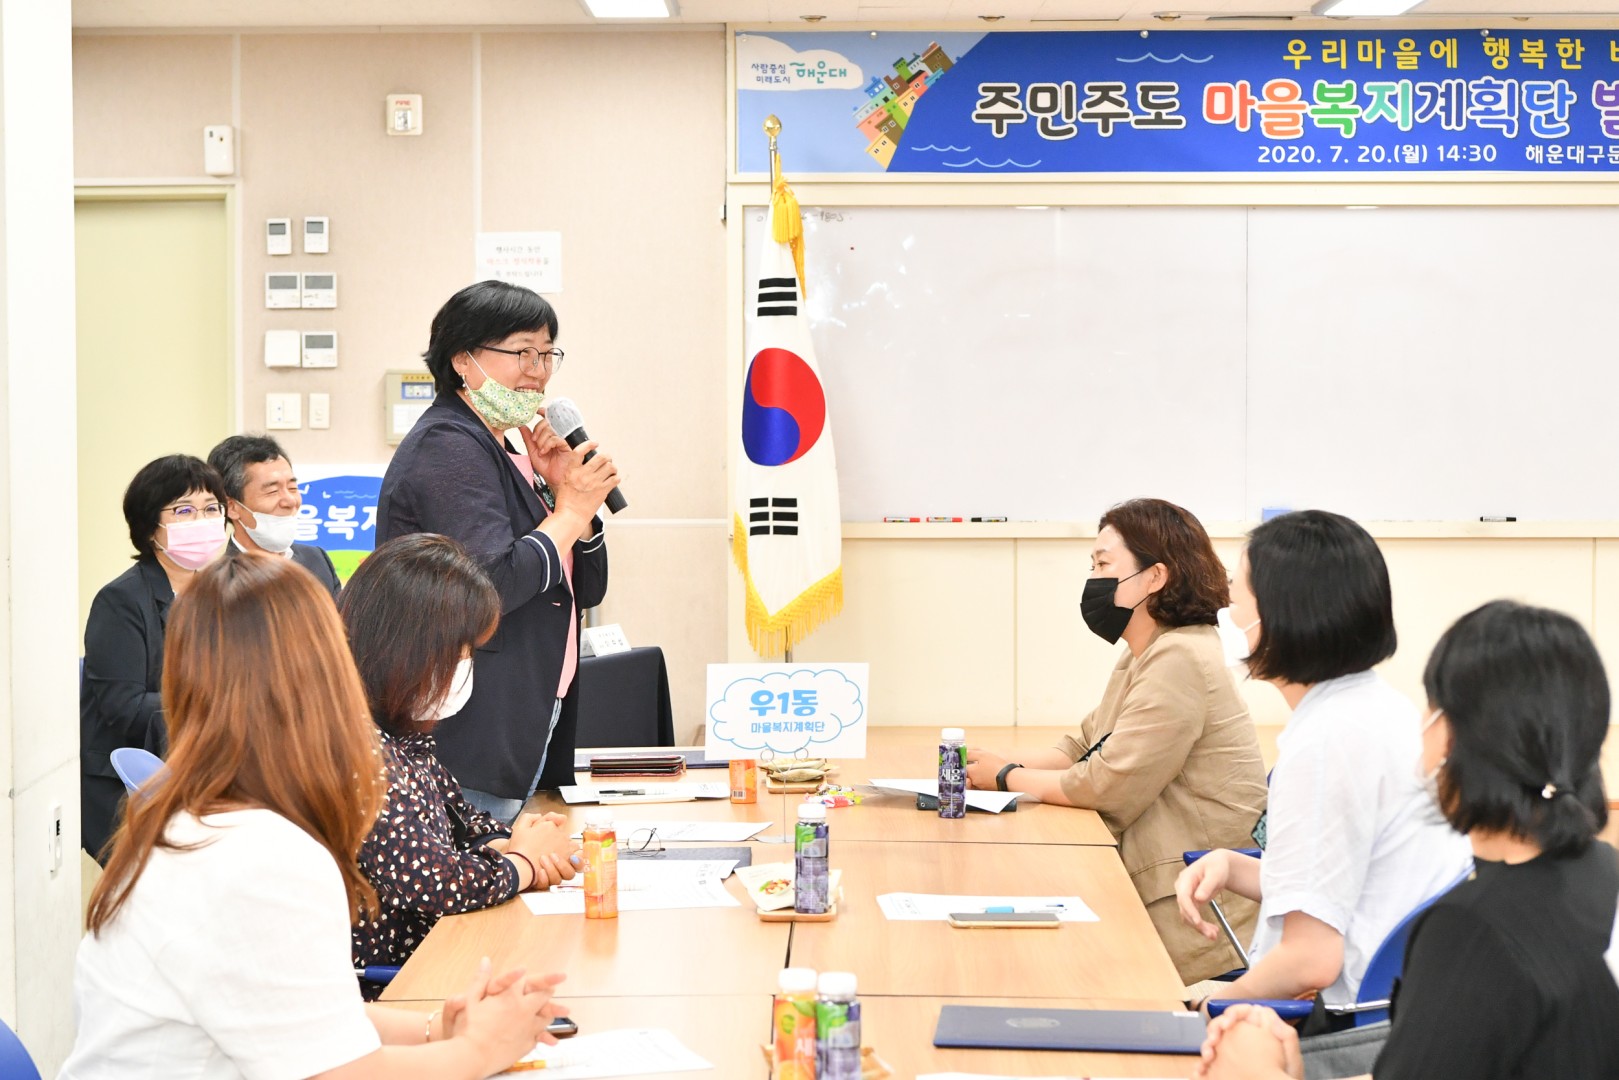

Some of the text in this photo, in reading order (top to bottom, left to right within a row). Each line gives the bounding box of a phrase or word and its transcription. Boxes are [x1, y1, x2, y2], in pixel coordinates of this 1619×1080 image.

[1283, 37, 1459, 69] 우리마을에
[1483, 37, 1586, 70] 행복한
[751, 62, 787, 75] 사람중심
[789, 60, 848, 84] 해운대
[756, 75, 791, 84] 미래도시
[972, 80, 1186, 140] 주민주도
[1202, 75, 1577, 139] 마을복지계획단
[1258, 146, 1322, 163] 2020.
[1330, 146, 1349, 163] 7.
[1357, 145, 1428, 164] 20.(월)
[1437, 145, 1497, 162] 14:30
[749, 690, 819, 716] 우1동
[751, 721, 825, 734] 마을복지계획단
